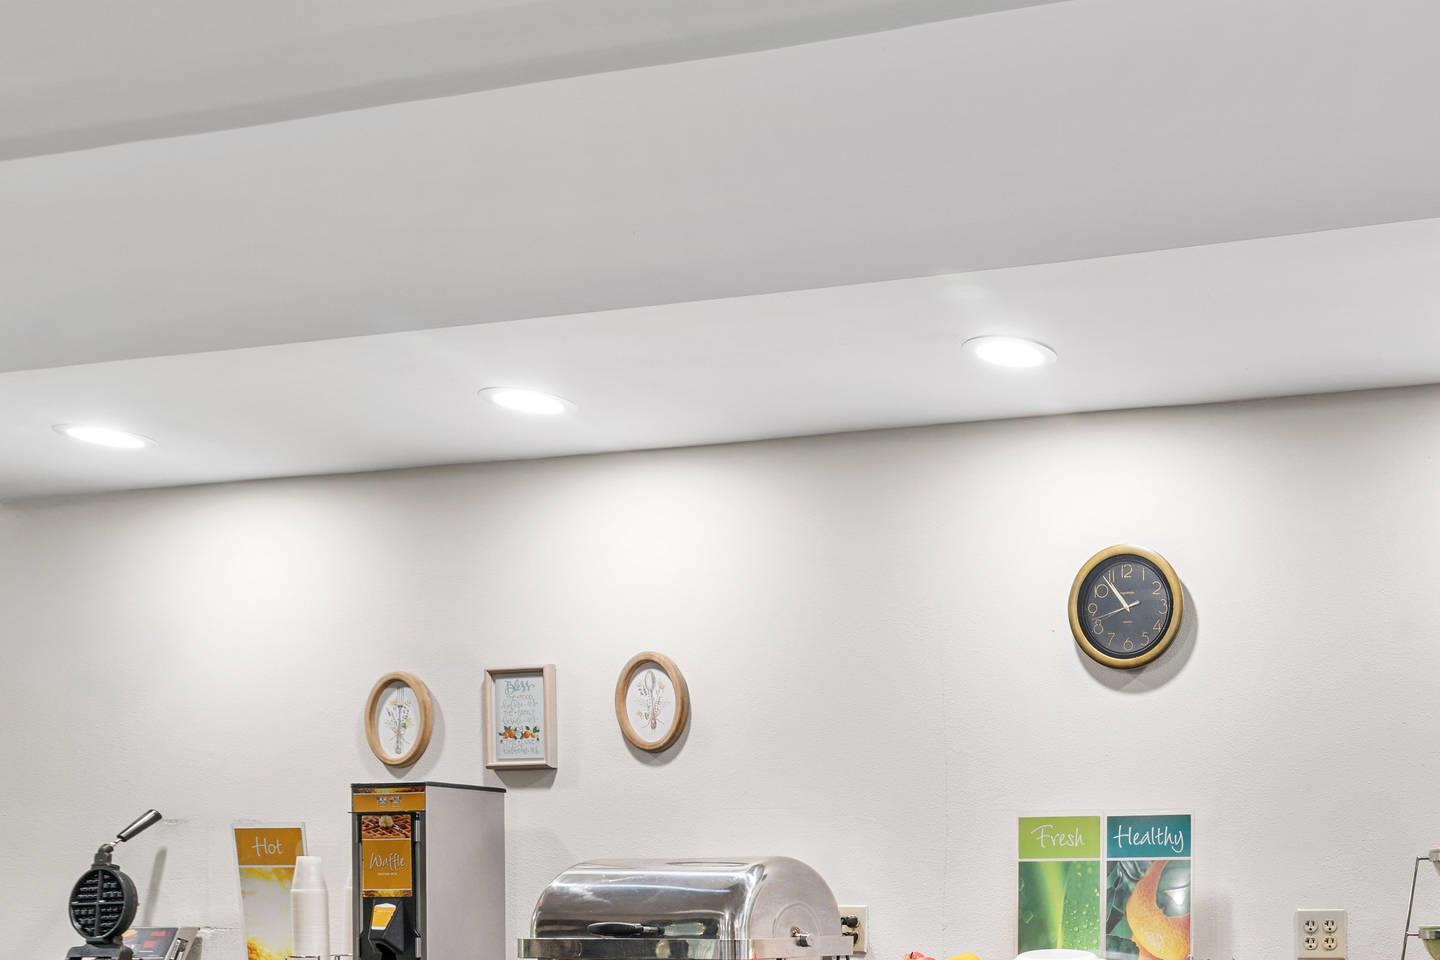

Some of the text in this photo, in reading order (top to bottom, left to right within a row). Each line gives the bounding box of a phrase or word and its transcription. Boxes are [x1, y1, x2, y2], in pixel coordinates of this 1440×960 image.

[1121, 563, 1133, 579] 12
[1094, 583, 1109, 599] 10
[1152, 581, 1162, 595] 2
[1087, 603, 1098, 617] 9
[1159, 598, 1168, 615] 3
[1093, 618, 1104, 635] 8
[1152, 619, 1161, 633] 4
[1107, 632, 1116, 647] 7
[1123, 637, 1133, 651] 6
[1141, 632, 1150, 647] 5
[1031, 824, 1085, 849] Fresh
[1113, 825, 1184, 853] Healthy
[251, 835, 284, 857] Hot
[369, 852, 407, 871] Waffle
